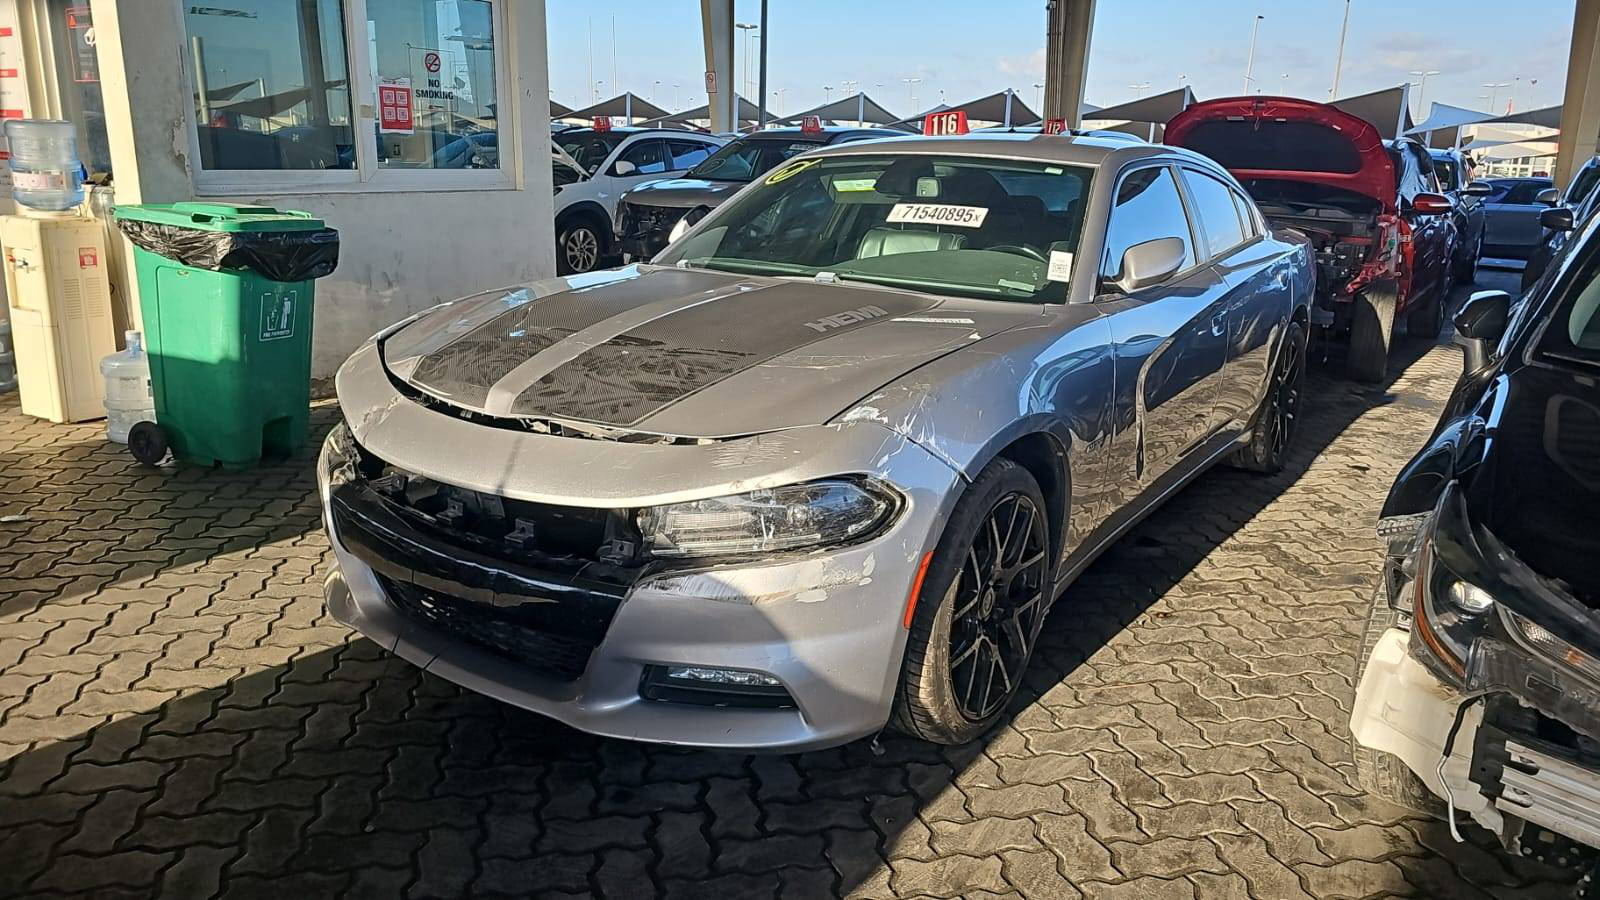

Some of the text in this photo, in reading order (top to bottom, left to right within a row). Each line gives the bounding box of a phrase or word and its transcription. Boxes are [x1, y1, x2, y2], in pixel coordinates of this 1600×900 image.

[428, 79, 440, 88] NO
[415, 90, 454, 100] SMOKING
[932, 114, 958, 136] 116
[804, 305, 889, 333] HEMI
